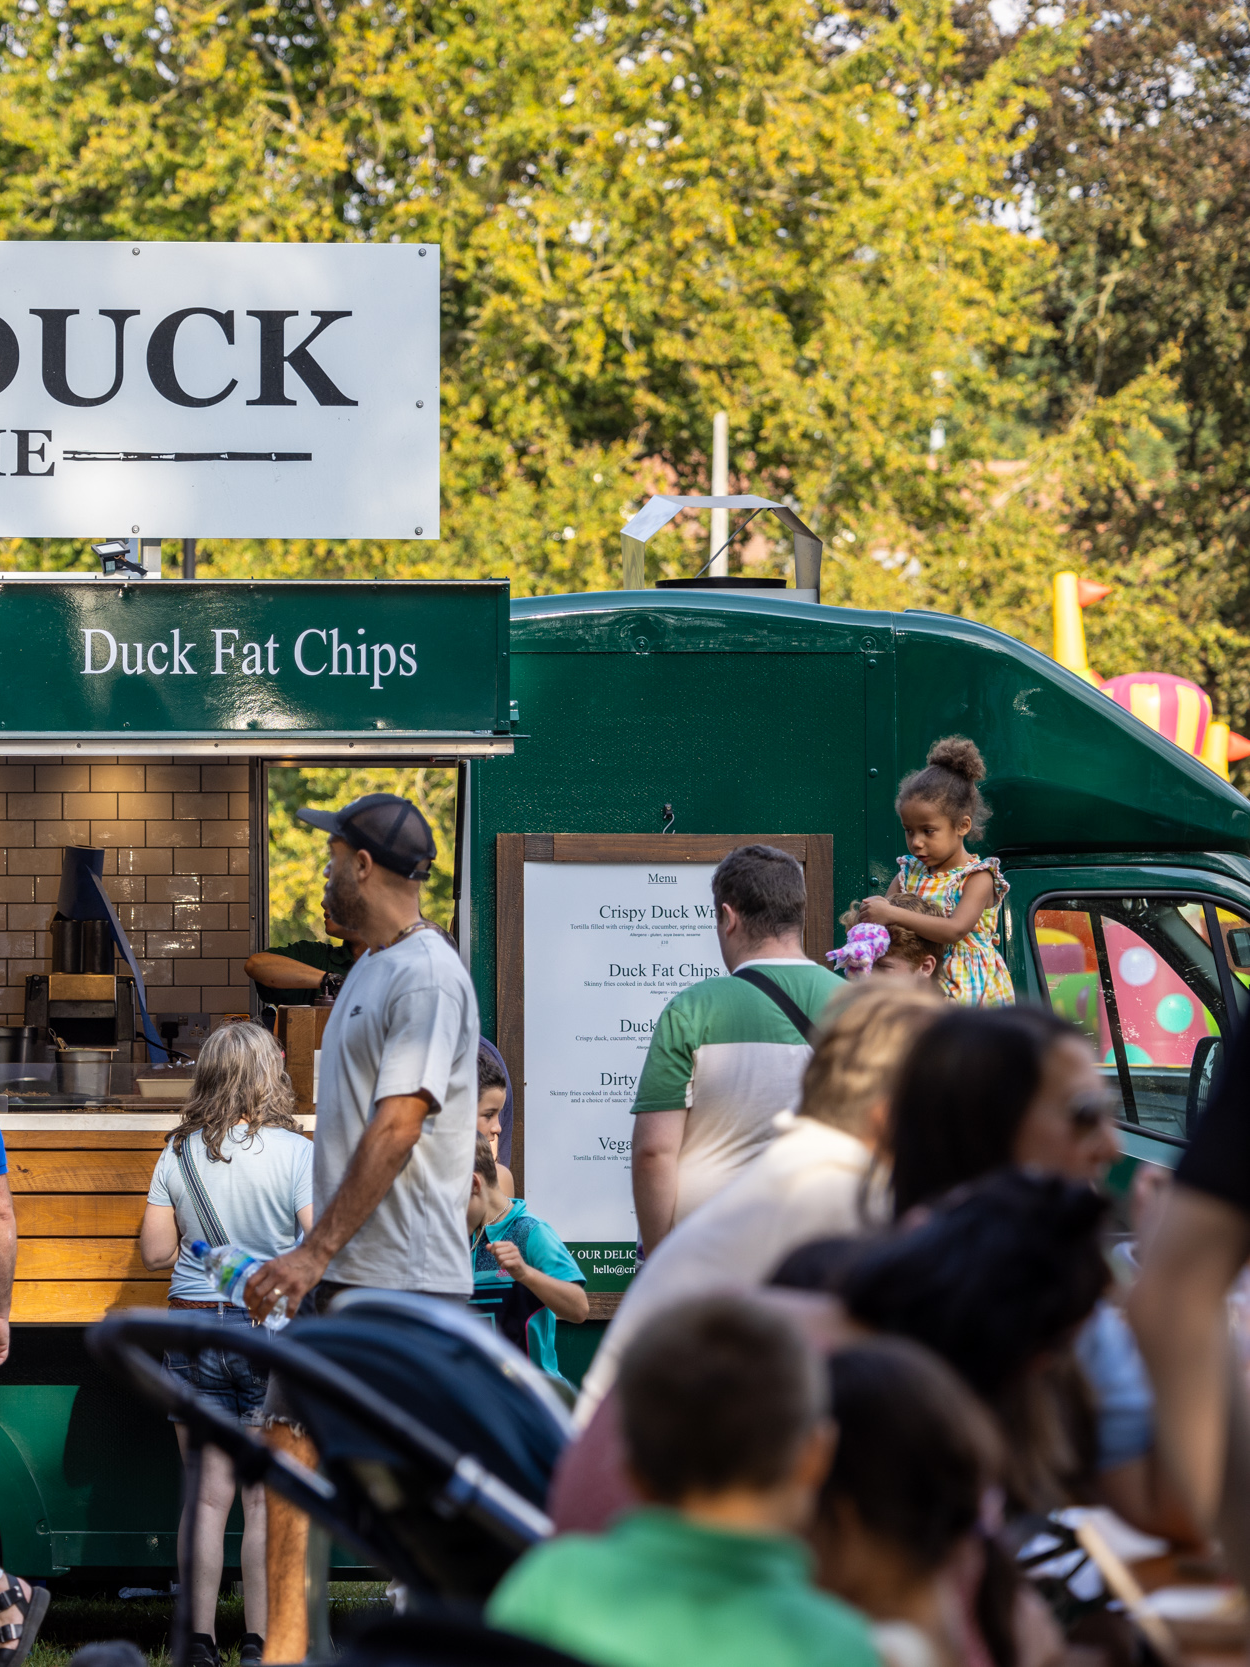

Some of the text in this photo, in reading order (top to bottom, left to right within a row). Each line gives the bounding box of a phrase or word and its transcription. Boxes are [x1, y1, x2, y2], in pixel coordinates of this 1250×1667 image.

[80, 627, 418, 690] Duck Fat Chips
[648, 873, 677, 884] Menu
[599, 905, 646, 922] Crispy
[651, 905, 689, 919] Duck
[609, 963, 720, 980] Duck Fat Chips
[620, 1019, 657, 1033] Duck
[600, 1072, 637, 1089] Dirty
[598, 1137, 632, 1154] Vega
[577, 1250, 601, 1260] OUR
[593, 1265, 636, 1276] hello@cri
